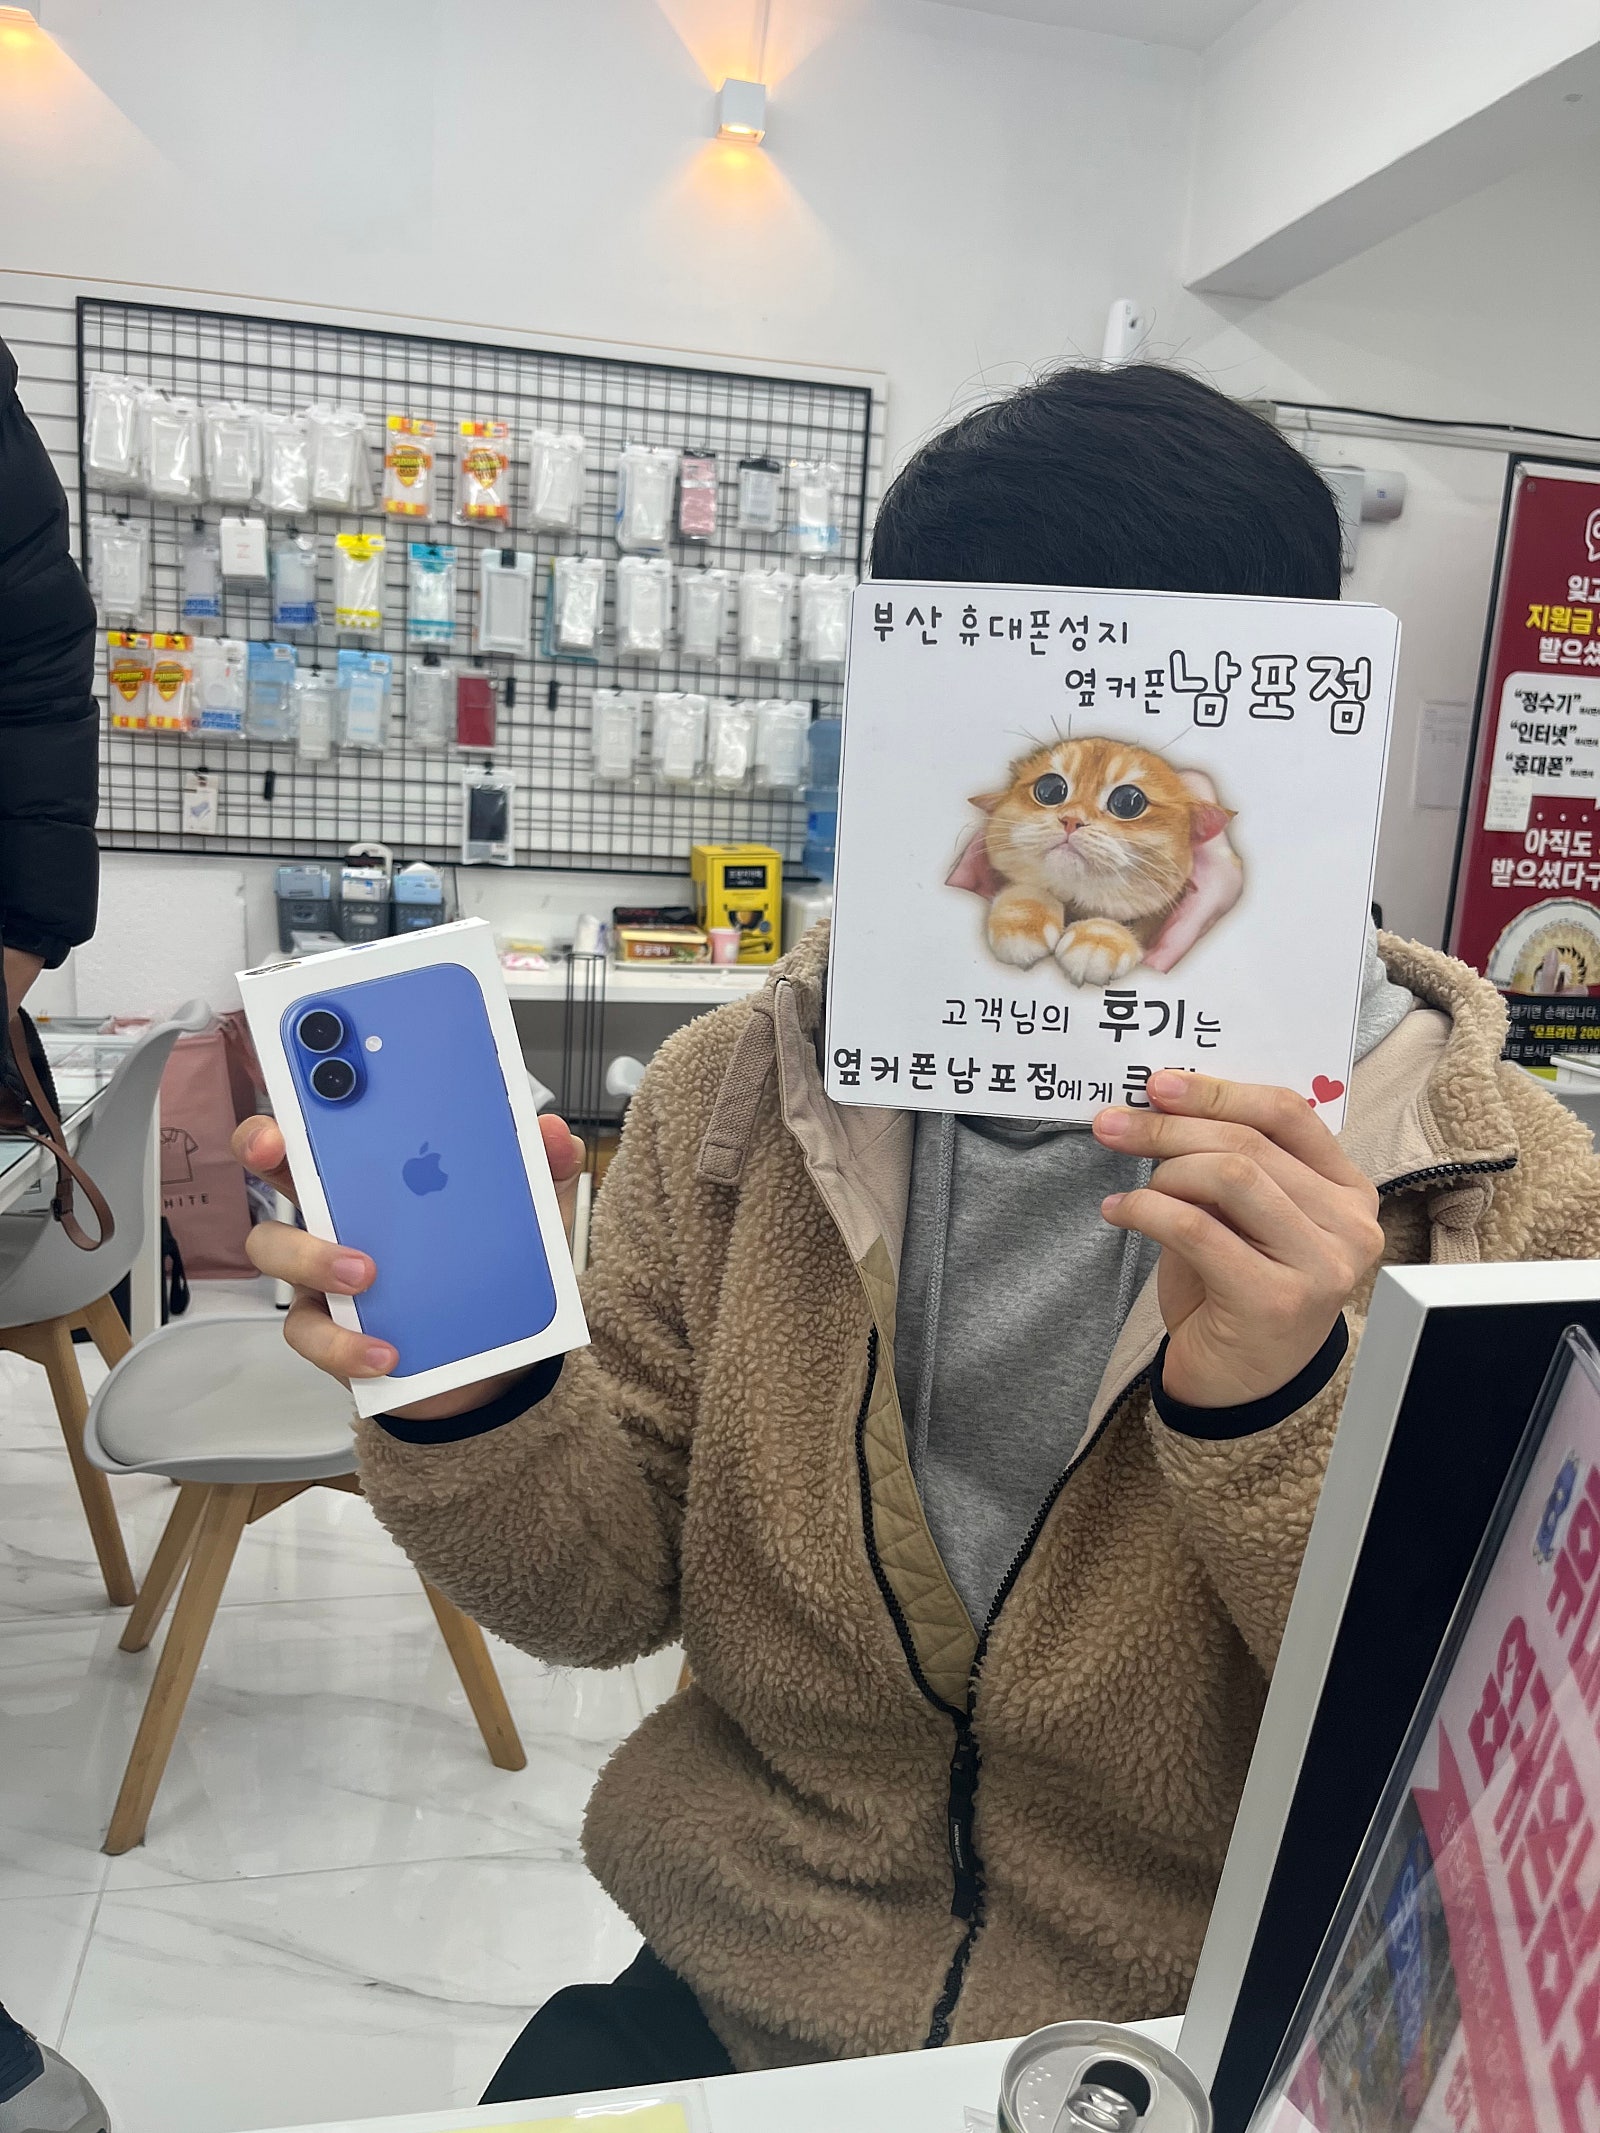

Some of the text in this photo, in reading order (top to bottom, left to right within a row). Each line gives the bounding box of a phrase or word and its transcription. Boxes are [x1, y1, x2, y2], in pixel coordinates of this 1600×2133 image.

[873, 603, 1130, 655] 부산 휴대폰성지
[1526, 604, 1593, 636] 지원금
[1524, 828, 1592, 858] 아직도
[941, 989, 1222, 1048] 고객님의 후기는
[833, 1047, 1151, 1109] 옆커폰남포점에게 큰
